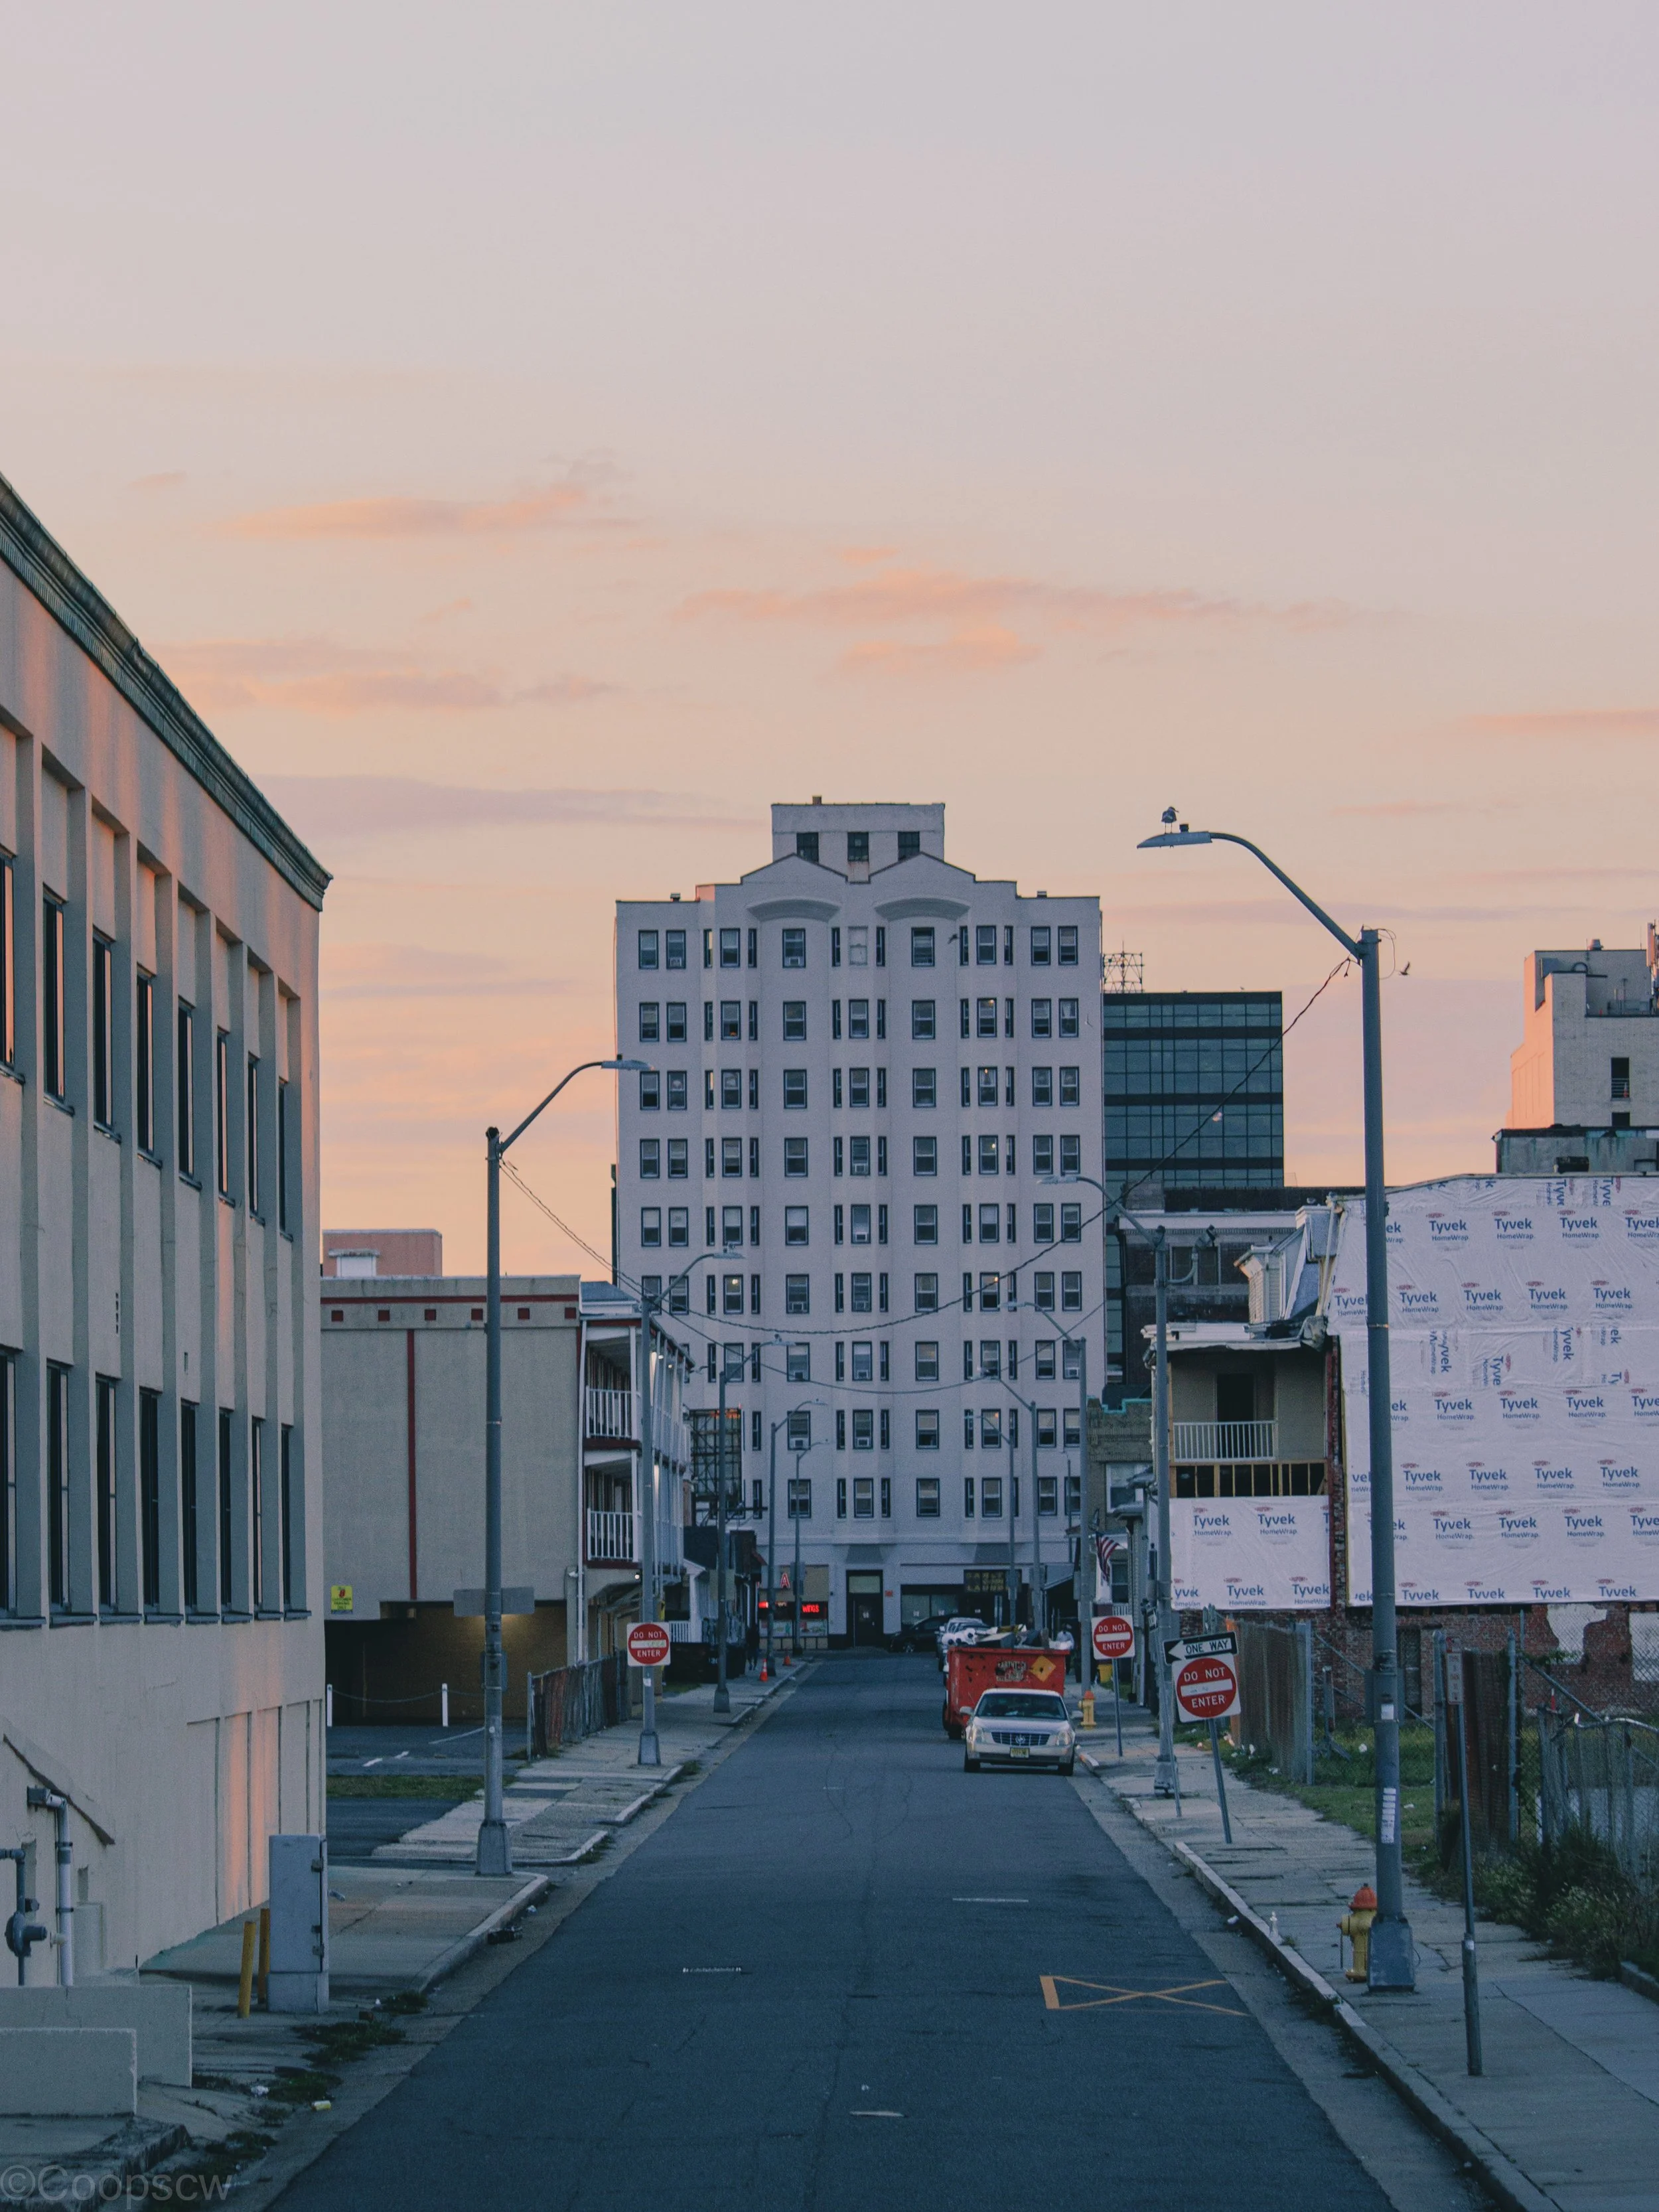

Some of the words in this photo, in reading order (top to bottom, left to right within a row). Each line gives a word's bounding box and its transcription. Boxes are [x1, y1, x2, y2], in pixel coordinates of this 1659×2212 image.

[1600, 1177, 1613, 1206] Tyve
[1429, 1220, 1467, 1234] Tyvek
[1494, 1218, 1532, 1232] Tyvek
[1560, 1217, 1597, 1231] Tyvek
[1334, 1293, 1368, 1309] Tyve
[1400, 1291, 1437, 1306] Tyvek
[1464, 1290, 1501, 1303] Tyvek
[1529, 1288, 1565, 1302] Tyvek
[1593, 1288, 1630, 1301] Tyvek
[1560, 1328, 1575, 1361] yvek
[1437, 1342, 1452, 1373] yvek
[1490, 1355, 1504, 1386] Tyve
[1435, 1398, 1472, 1413] Tyvek
[1500, 1398, 1538, 1412] Tyvek
[1566, 1396, 1603, 1410] Tyvek
[1632, 1396, 1659, 1410] Tyve
[1404, 1471, 1441, 1484] Tyvek
[1469, 1469, 1507, 1483] Tyvek
[1535, 1467, 1572, 1482] Tyvek
[1601, 1467, 1638, 1481] Tyvek
[1194, 1514, 1229, 1529] Tyvek
[1258, 1513, 1295, 1528] Tyvek
[1433, 1518, 1471, 1532] Tyvek
[1499, 1517, 1536, 1531] Tyvek
[1565, 1515, 1602, 1530] Tyvek
[1630, 1515, 1659, 1528] Tyve
[1227, 1585, 1263, 1599] Tyvek
[1292, 1584, 1329, 1597] Tyvek
[1533, 1587, 1570, 1598] Tyvek
[1599, 1585, 1636, 1597] Tyvek
[1102, 1641, 1125, 1651] ENTER
[1185, 1643, 1204, 1654] ONE
[1209, 1640, 1228, 1651] WAY
[1183, 1672, 1198, 1682] DO
[1205, 1666, 1225, 1678] NOT
[1191, 1695, 1226, 1708] ENTER
